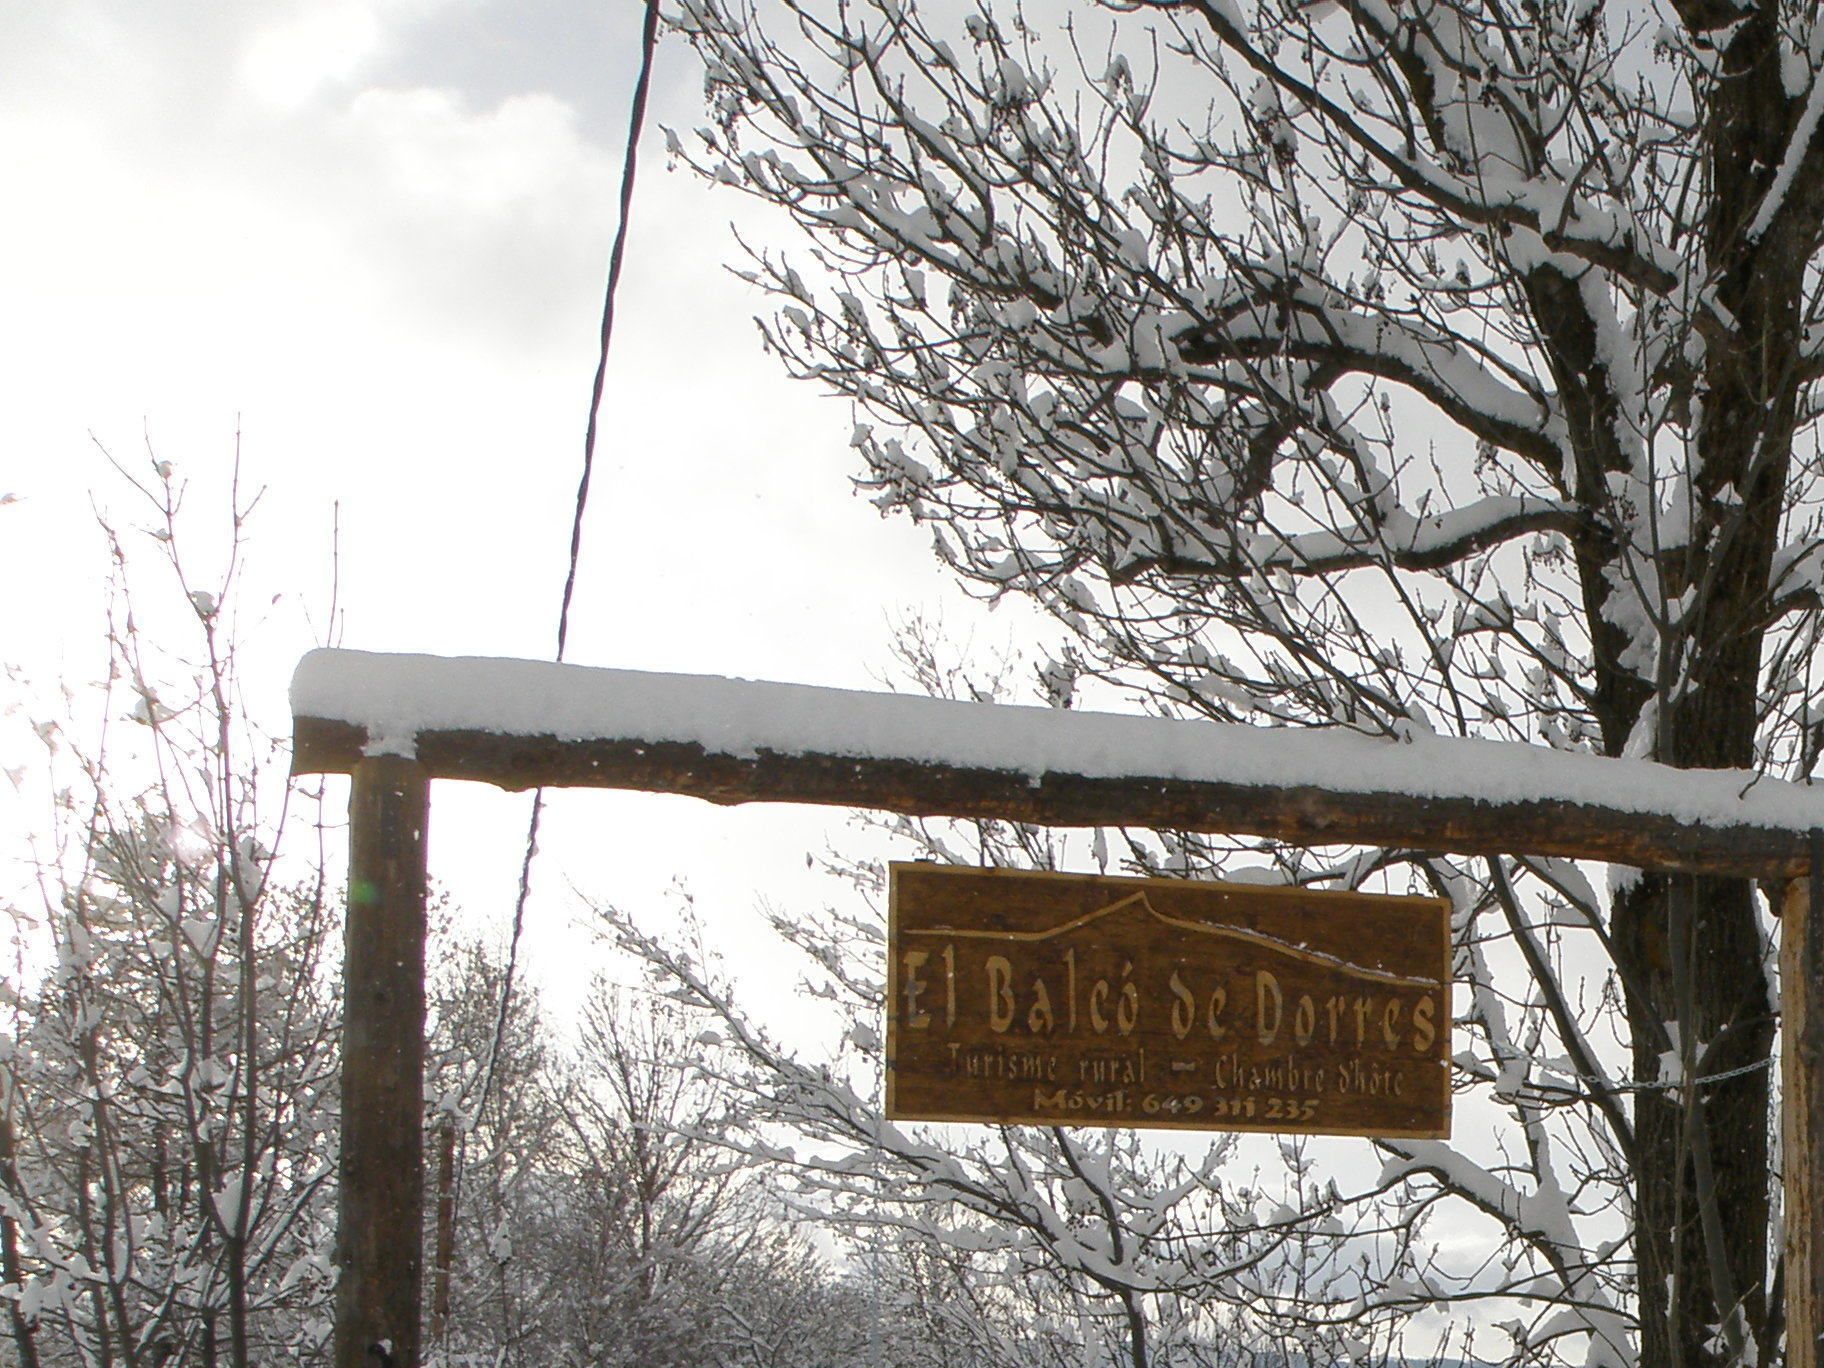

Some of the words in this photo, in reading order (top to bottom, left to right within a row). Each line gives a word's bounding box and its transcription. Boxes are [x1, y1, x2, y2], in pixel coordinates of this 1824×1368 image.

[903, 943, 956, 1029] El
[985, 947, 1139, 1036] Balcó
[1169, 969, 1227, 1041] de
[1256, 969, 1436, 1052] Dorres
[947, 1041, 1057, 1082] Turisme
[1079, 1047, 1146, 1084] rural
[1214, 1053, 1325, 1094] Chambre
[1141, 1093, 1203, 1115] 649
[1213, 1095, 1256, 1118] 311
[1264, 1096, 1320, 1121] 235
